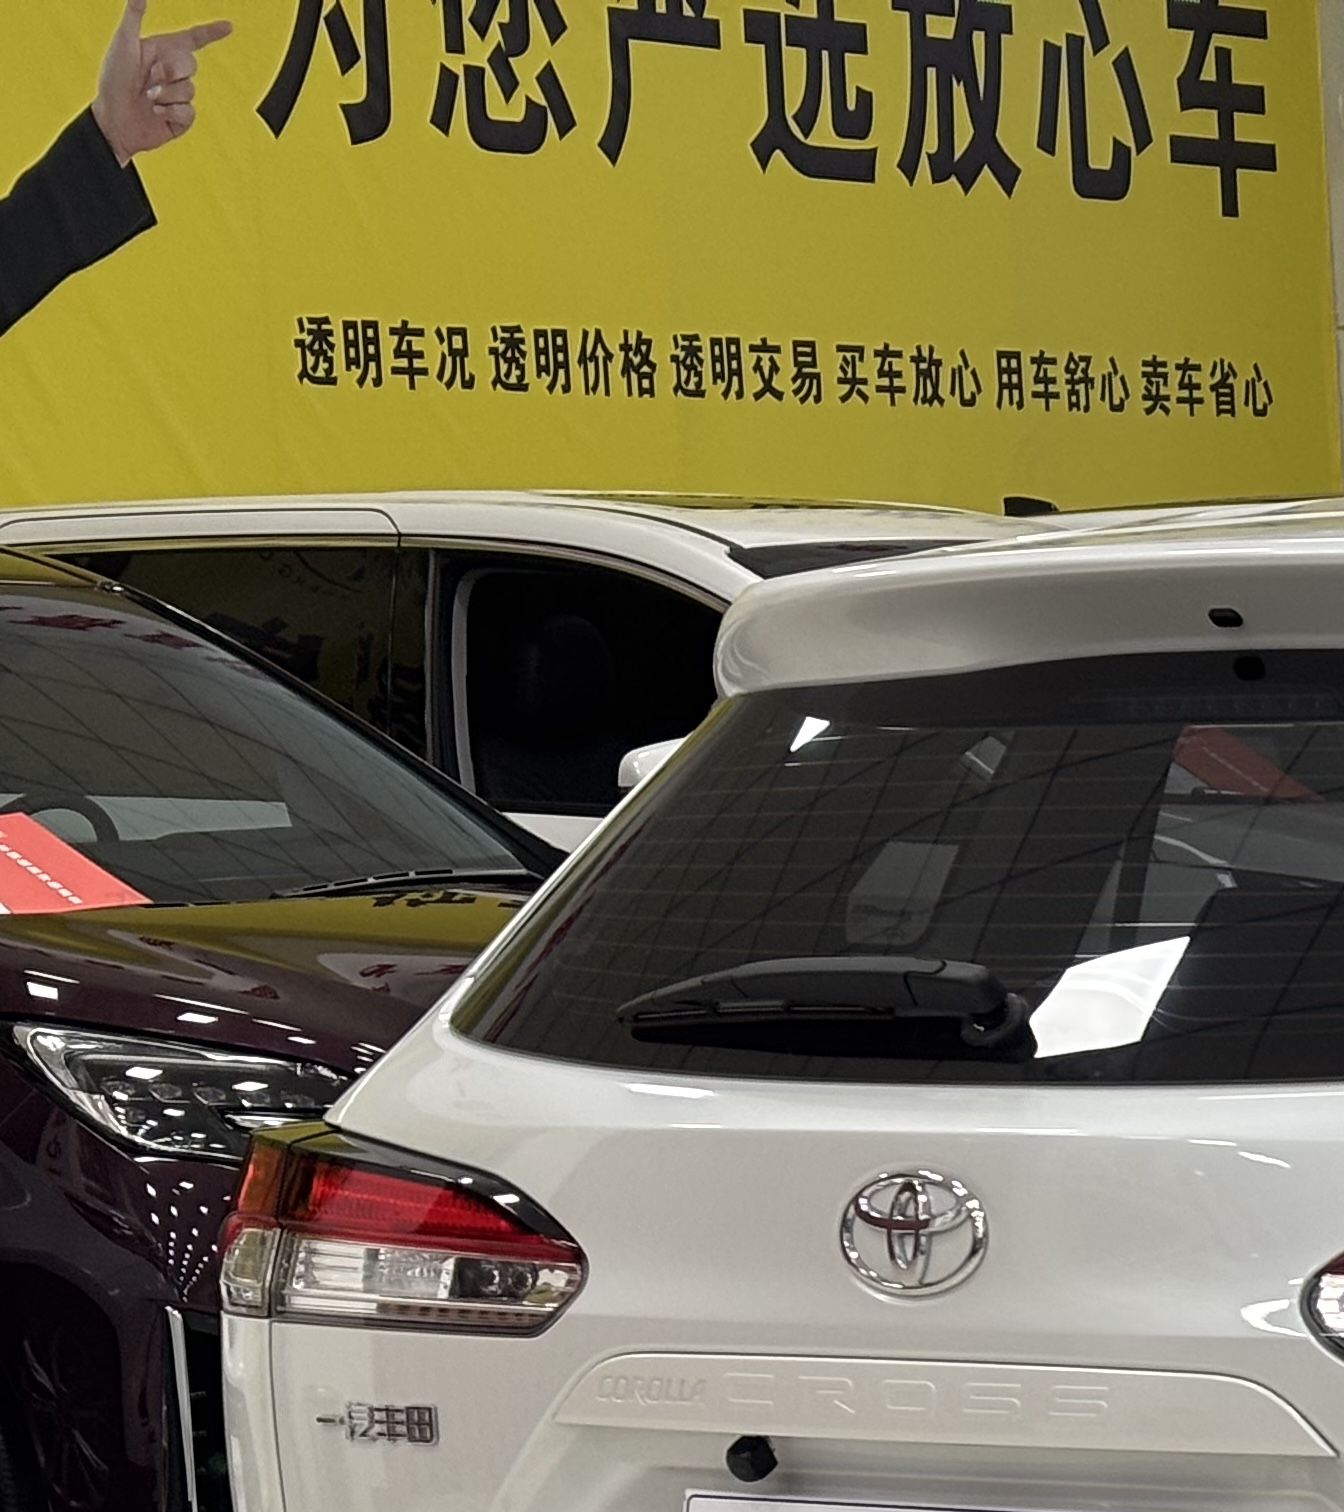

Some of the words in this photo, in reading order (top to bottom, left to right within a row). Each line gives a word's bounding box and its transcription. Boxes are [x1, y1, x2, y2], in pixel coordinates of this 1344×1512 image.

[294, 315, 476, 391] 透明车况
[488, 324, 657, 398] 透明价格
[670, 333, 823, 405] 透明交易
[835, 342, 983, 408] 买车放心
[995, 350, 1131, 414] 用车舒心
[1140, 355, 1274, 418] 卖车省心
[723, 1372, 1110, 1416] CROSS
